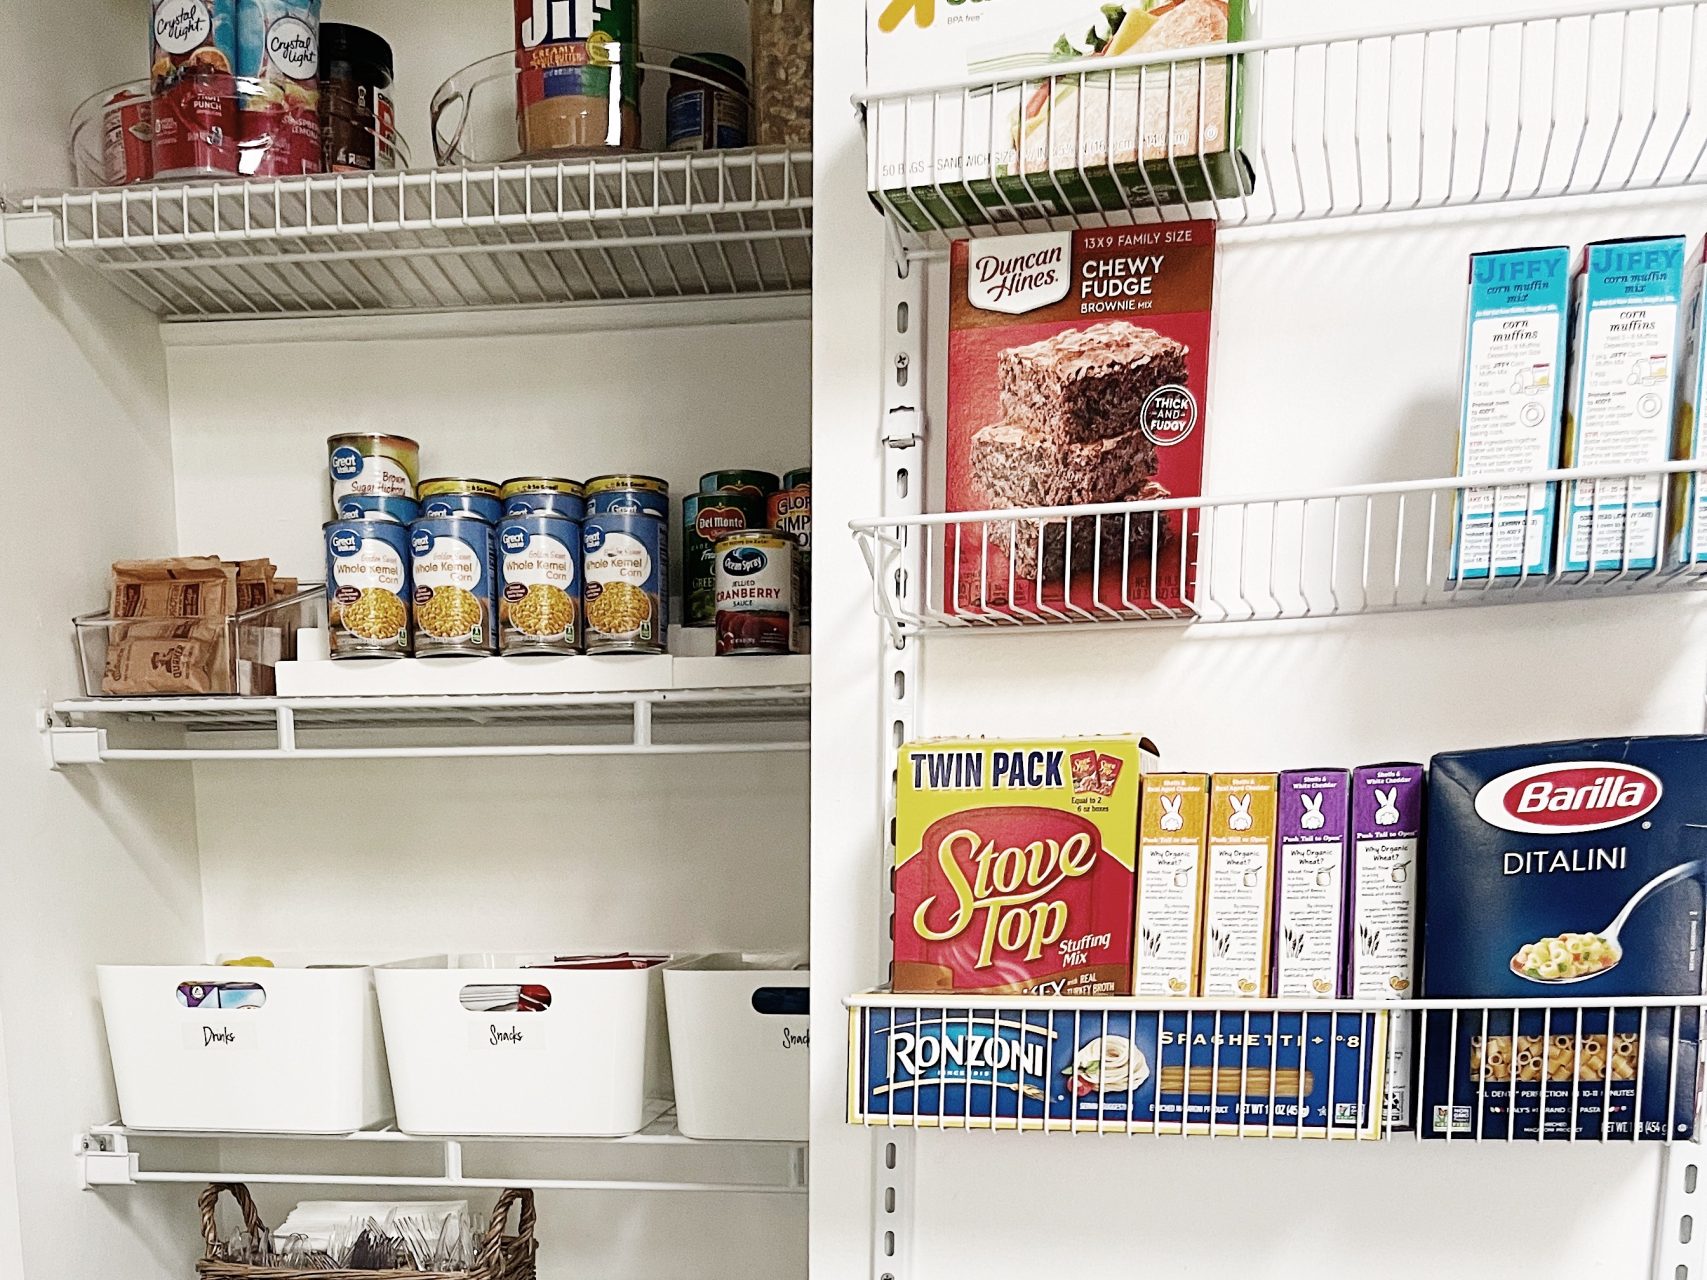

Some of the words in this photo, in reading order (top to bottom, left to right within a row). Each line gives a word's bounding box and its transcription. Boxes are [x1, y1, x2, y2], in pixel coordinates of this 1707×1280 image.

[156, 2, 197, 36] Crystal
[947, 16, 964, 25] BPA
[270, 28, 311, 54] Crystal
[193, 100, 222, 111] PUNCH
[882, 165, 895, 177] 50
[898, 160, 925, 175] BGS
[1117, 231, 1162, 247] FAMILY
[1164, 229, 1193, 243] SIZE
[975, 246, 1062, 283] Duncan
[1081, 255, 1165, 280] CHEWY
[1593, 249, 1680, 274] JIFFY
[1476, 257, 1563, 284] JIFFY
[1603, 275, 1628, 285] corn
[1630, 271, 1668, 283] muffin
[1080, 276, 1153, 300] FUDGE
[1486, 283, 1511, 294] corn
[1513, 280, 1550, 292] muffin
[1624, 284, 1647, 294] mix
[1506, 293, 1530, 304] mix
[1080, 300, 1136, 314] BROWNIE
[1137, 300, 1153, 310] MIX
[1619, 310, 1647, 320] corn
[1502, 319, 1529, 330] corn
[1609, 321, 1656, 333] muffins
[1492, 330, 1539, 343] muffins
[1154, 397, 1189, 411] THICK
[1150, 419, 1187, 432] FUDGY
[332, 455, 357, 468] Great
[336, 465, 357, 475] Value
[382, 472, 406, 484] Brown
[350, 482, 375, 493] Sugar
[776, 497, 811, 516] GLOR
[699, 517, 713, 529] Del
[714, 516, 743, 529] Monte
[775, 516, 811, 535] SIMP
[333, 536, 356, 547] Great
[411, 534, 429, 547] Great
[502, 532, 525, 544] Great
[338, 545, 357, 553] Value
[336, 564, 367, 574] Whole
[506, 559, 534, 571] Whole
[536, 559, 567, 571] Kernel
[610, 557, 643, 569] Kernel
[724, 559, 743, 571] Ocean
[742, 556, 763, 573] Spray
[545, 571, 568, 581] Corn
[619, 568, 643, 578] Corn
[378, 575, 400, 585] Corn
[692, 576, 716, 589] GREE
[731, 579, 756, 588] JELLIED
[716, 587, 781, 603] CRANBERRY
[732, 599, 753, 608] SAUCE
[171, 643, 186, 680] QUAKER
[911, 751, 983, 789] TWIN
[993, 750, 1064, 787] PACK
[1071, 796, 1088, 804] Equal
[1097, 796, 1102, 804] 2
[1516, 775, 1648, 813] Barilla
[1356, 832, 1374, 840] Push
[1375, 831, 1388, 839] Tail
[1150, 850, 1163, 858] Why
[1164, 850, 1190, 858] Organic
[1219, 850, 1232, 858] Why
[1233, 850, 1260, 858] Organic
[1291, 850, 1305, 858] Why
[1306, 849, 1333, 858] Organic
[1365, 846, 1380, 854] Why
[1380, 845, 1409, 854] Organic
[1299, 858, 1325, 866] Wheat?
[1373, 853, 1400, 862] Wheat?
[1503, 847, 1627, 875] DITALINI
[914, 828, 1098, 941] Stove
[973, 900, 1068, 970] Top
[1058, 933, 1112, 956] Stuffing
[1062, 952, 1088, 968] Mix
[1079, 972, 1097, 982] REAL
[1092, 981, 1116, 993] BROTH
[489, 1023, 524, 1047] Snacks
[782, 1027, 811, 1049] Snac
[1346, 1036, 1361, 1049] 8
[887, 1031, 1044, 1078] RONZONI
[1521, 1089, 1569, 1098] PERFCTION
[1236, 1103, 1249, 1114] NET
[1251, 1103, 1263, 1114] WT
[1274, 1104, 1287, 1115] OZ
[1579, 1106, 1602, 1114] PASTA
[1644, 1120, 1661, 1135] (454
